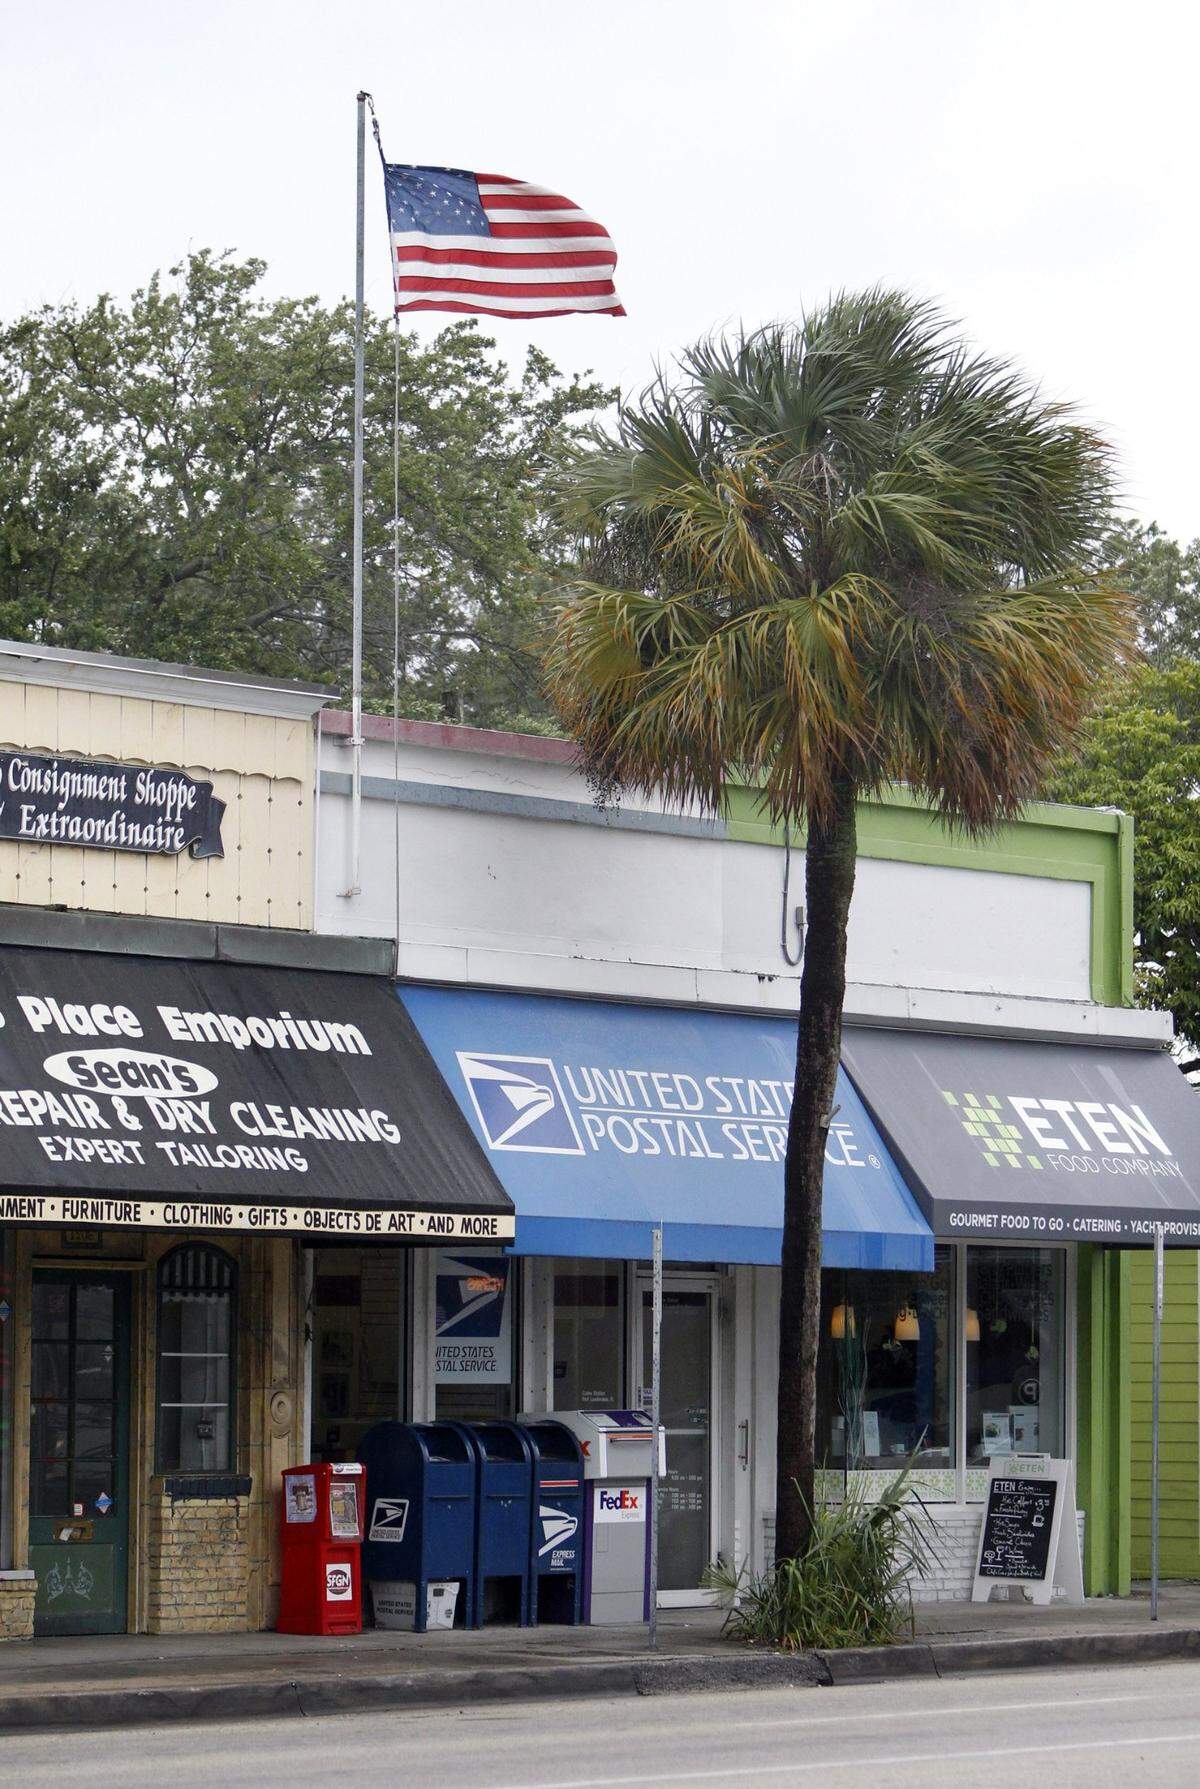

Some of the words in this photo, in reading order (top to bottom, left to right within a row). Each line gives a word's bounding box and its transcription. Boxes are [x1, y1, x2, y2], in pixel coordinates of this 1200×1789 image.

[8, 758, 128, 811] Consignment
[134, 769, 197, 823] Shoppe
[18, 804, 186, 850] Extraordinaire
[16, 996, 144, 1038] Place
[156, 1006, 373, 1056] Emporium
[564, 1066, 704, 1111] UNITED
[705, 1076, 795, 1117] STAT
[111, 1095, 143, 1131] &
[144, 1096, 217, 1135] DRY
[229, 1102, 401, 1145] CLEANING
[1007, 1096, 1172, 1156] ETEN
[581, 1114, 724, 1159] POSTAL
[722, 1123, 866, 1167] SERCE
[38, 1136, 146, 1165] EXPERT
[155, 1141, 308, 1173] TAILORING
[1047, 1154, 1100, 1174] FOOD
[1102, 1157, 1184, 1178] COMPANY
[62, 1199, 141, 1222] FURNITURE
[164, 1205, 233, 1225] CLOTHING
[248, 1207, 287, 1227] GIFTS
[304, 1210, 361, 1231] OBJECTS
[388, 1213, 415, 1232] ART
[427, 1216, 454, 1234] AND
[460, 1217, 498, 1236] MORE
[949, 1213, 998, 1229] GOURMET
[1001, 1215, 1030, 1230] FOOD
[1032, 1217, 1046, 1231] TO
[1048, 1217, 1064, 1232] GO
[1073, 1219, 1121, 1233] CATERING
[1130, 1220, 1161, 1234] YACHT
[461, 1346, 495, 1358] STATES
[435, 1360, 458, 1372] STAL
[459, 1360, 497, 1372] SERVICE
[1019, 1463, 1045, 1473] ETEN
[994, 1481, 1016, 1492] ETEN
[601, 1490, 638, 1510] FedEx
[550, 1559, 565, 1567] MAIL
[552, 1550, 576, 1559] EXPRESS
[327, 1575, 349, 1588] SFGN
